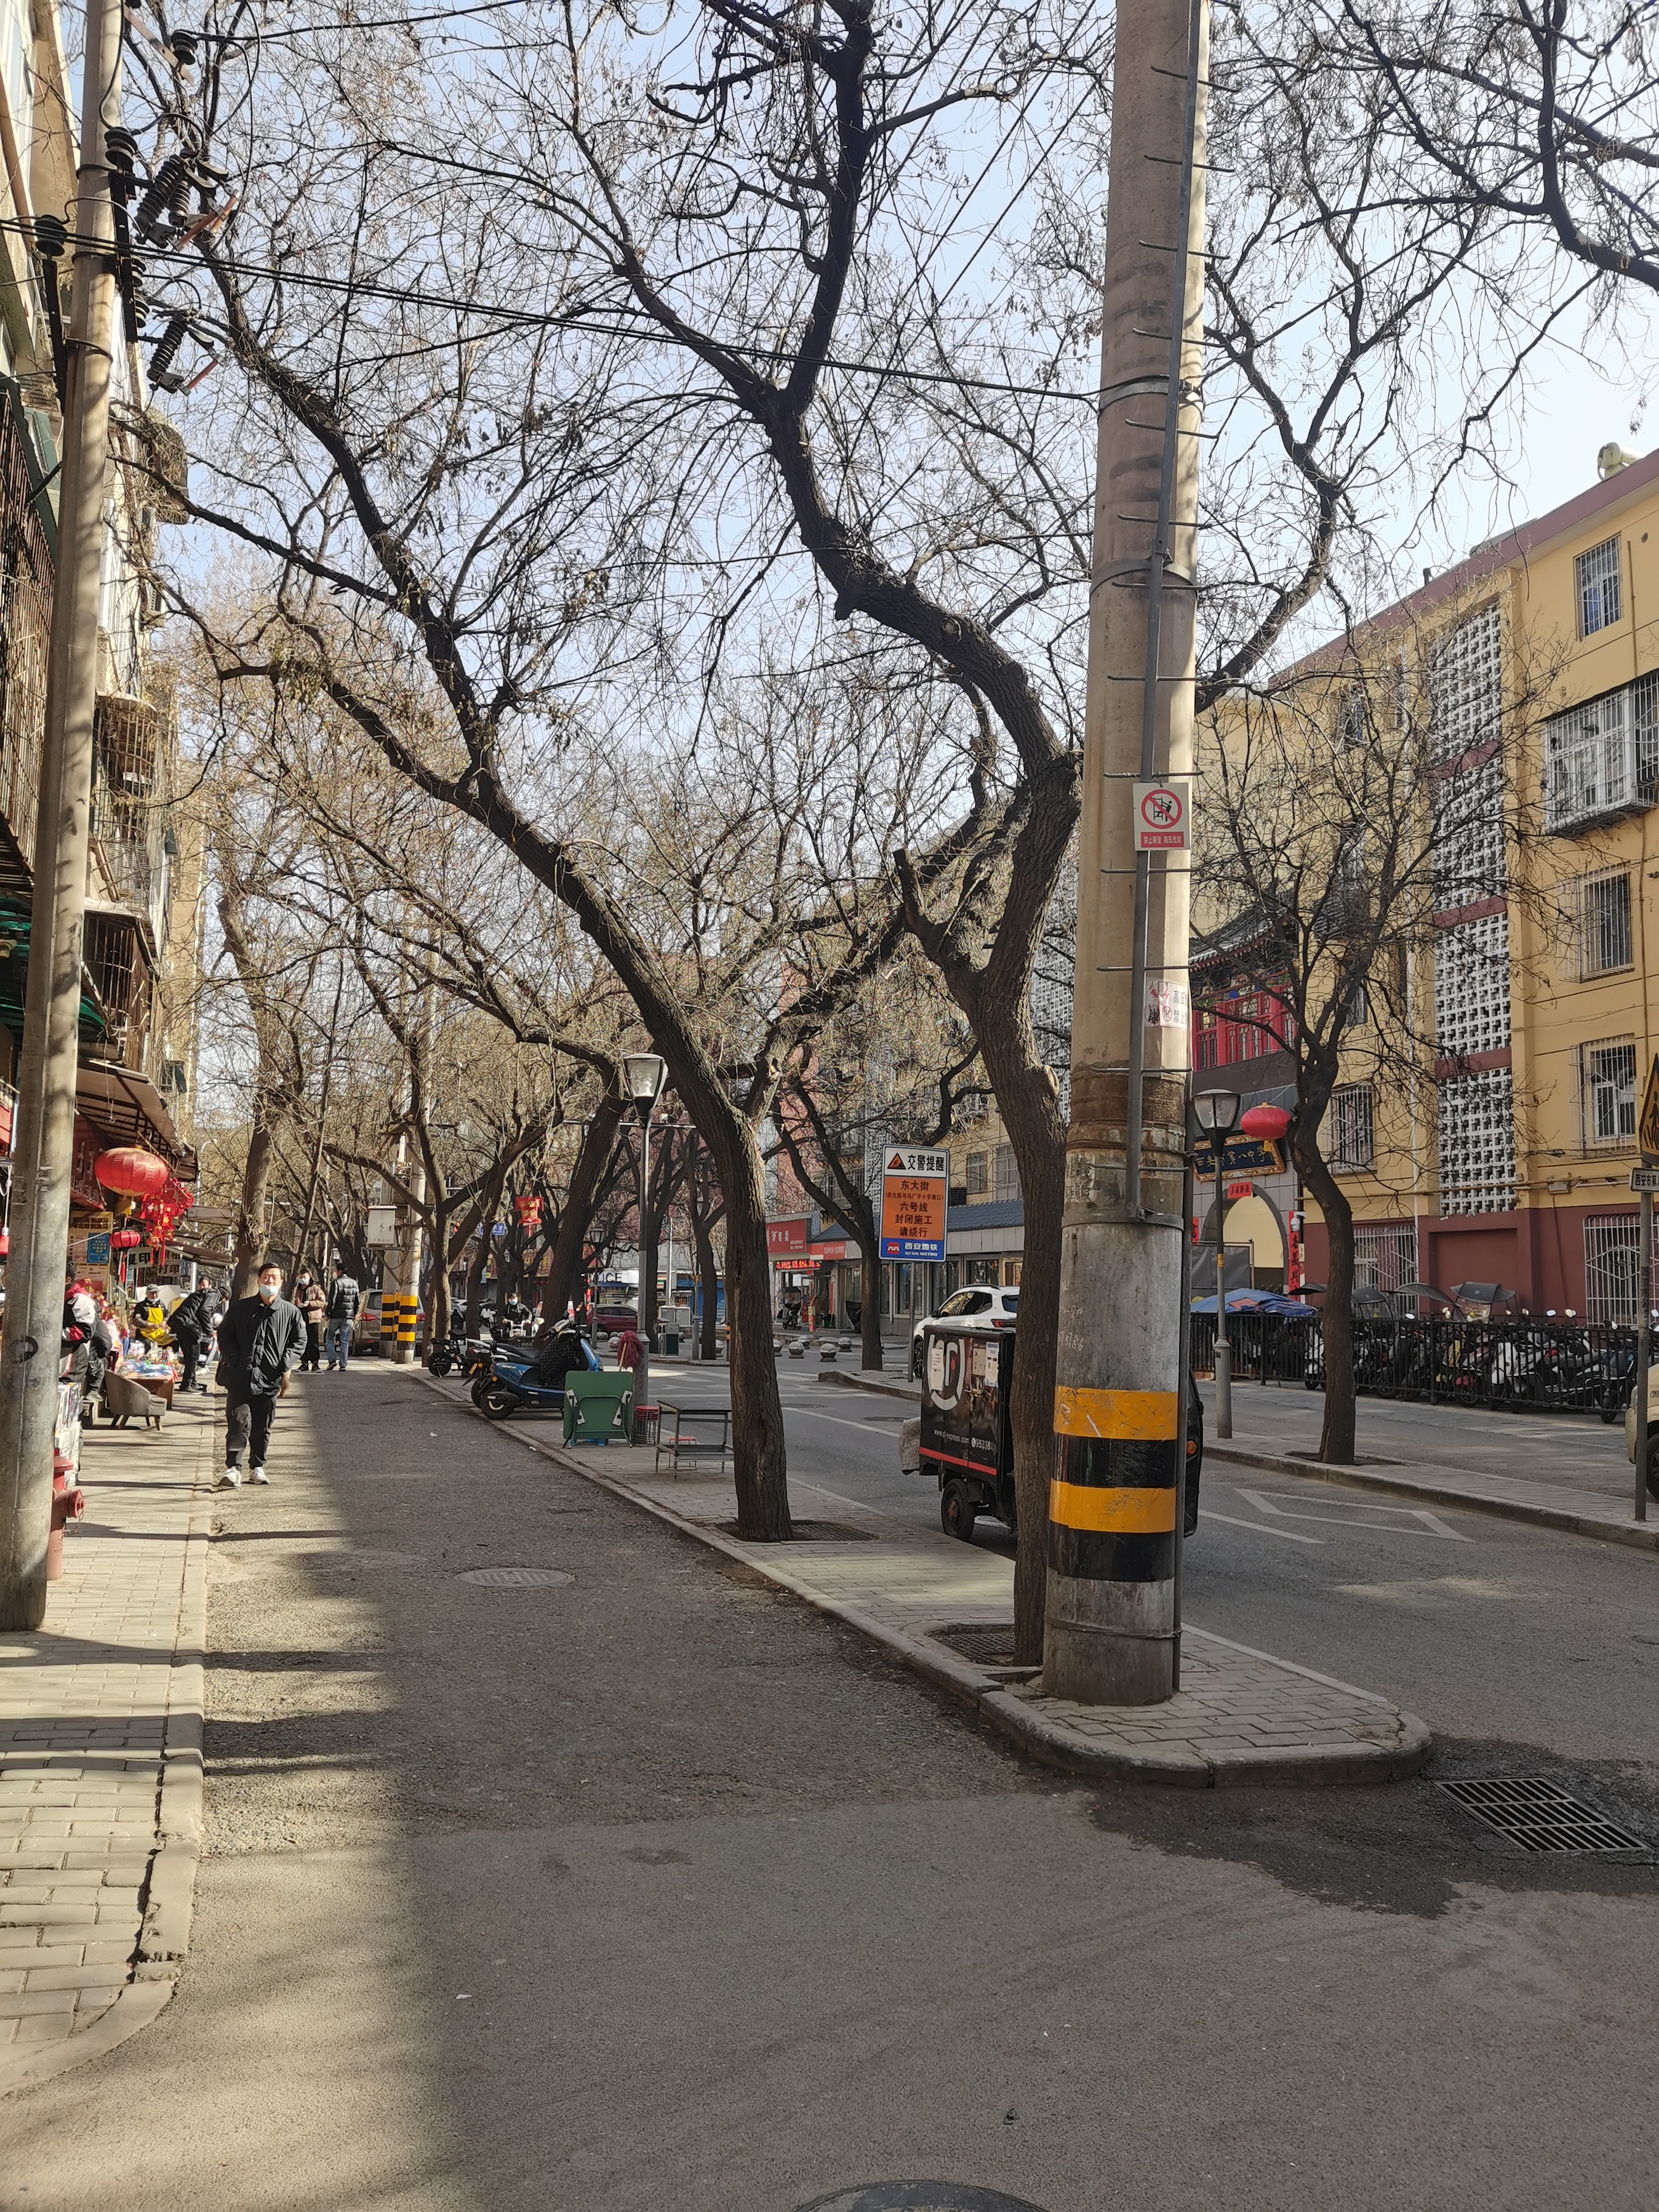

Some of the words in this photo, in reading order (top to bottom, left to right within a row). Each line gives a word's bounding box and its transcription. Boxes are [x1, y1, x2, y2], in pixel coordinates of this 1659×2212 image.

[908, 1154, 944, 1171] 交警提醒
[901, 1180, 929, 1191] 东大街
[900, 1201, 928, 1212] 六号线
[894, 1213, 933, 1224] 封闭施工
[899, 1226, 928, 1237] 请绕行
[905, 1242, 938, 1250] 西安地铁
[158, 1264, 180, 1275] 打印
[976, 1438, 991, 1450] 95338
